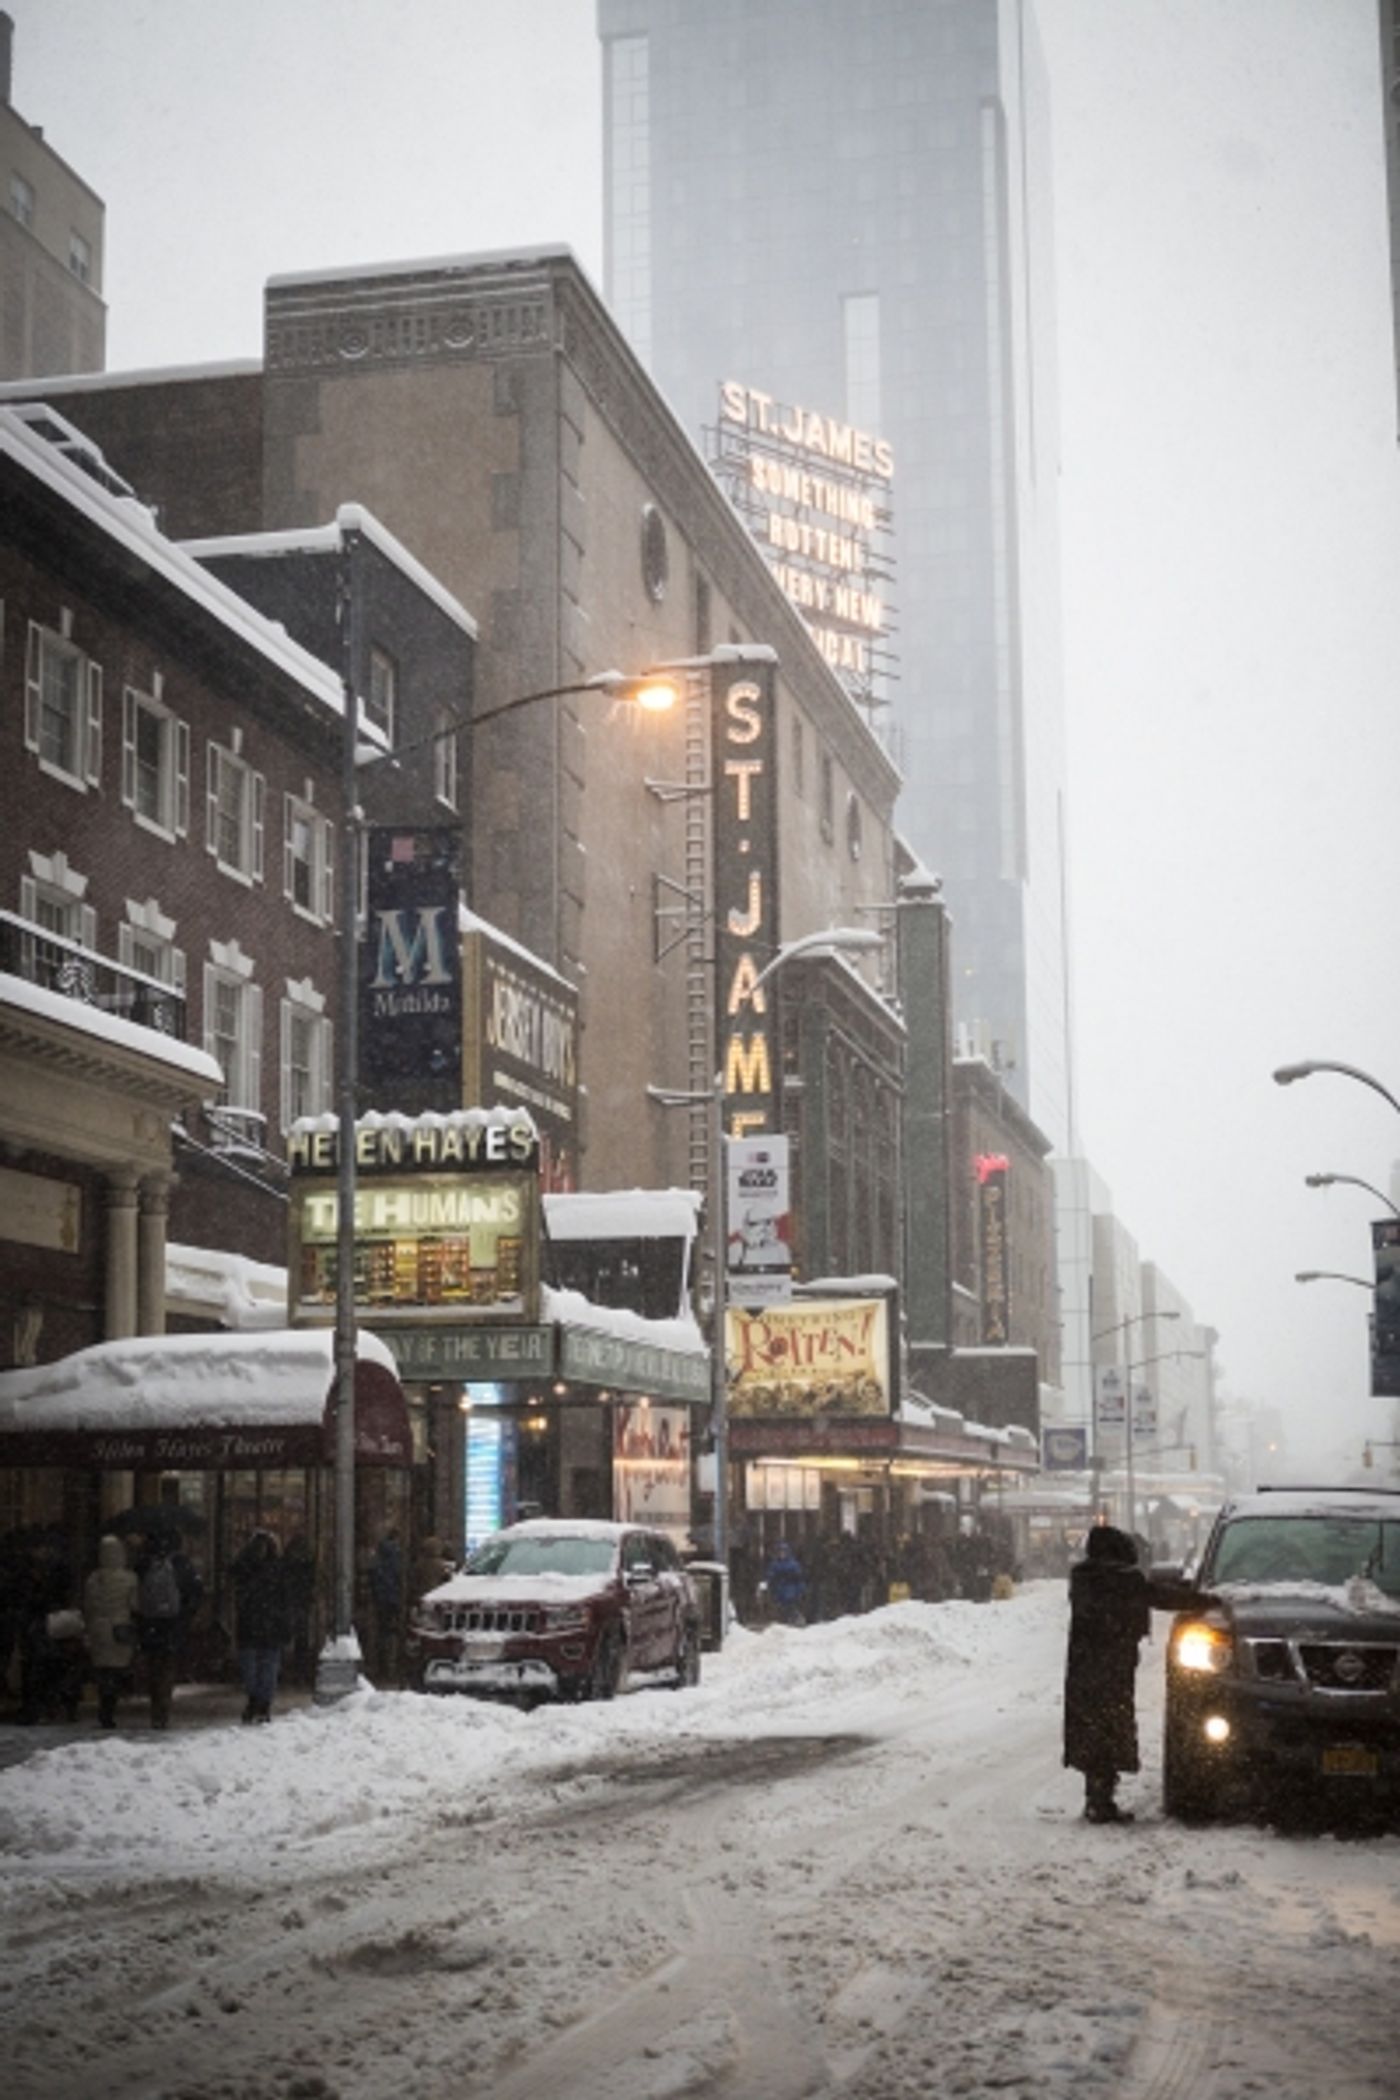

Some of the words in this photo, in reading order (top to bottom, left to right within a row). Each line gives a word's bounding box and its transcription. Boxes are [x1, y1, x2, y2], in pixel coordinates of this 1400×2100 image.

[752, 455, 874, 530] SOMETHING
[836, 584, 881, 630] NEW
[368, 906, 452, 989] M
[286, 1128, 402, 1167] HEEN
[414, 1123, 532, 1162] HAYES
[305, 1192, 362, 1227] TE
[373, 1189, 519, 1228] HUMANS
[442, 1335, 481, 1361] THE
